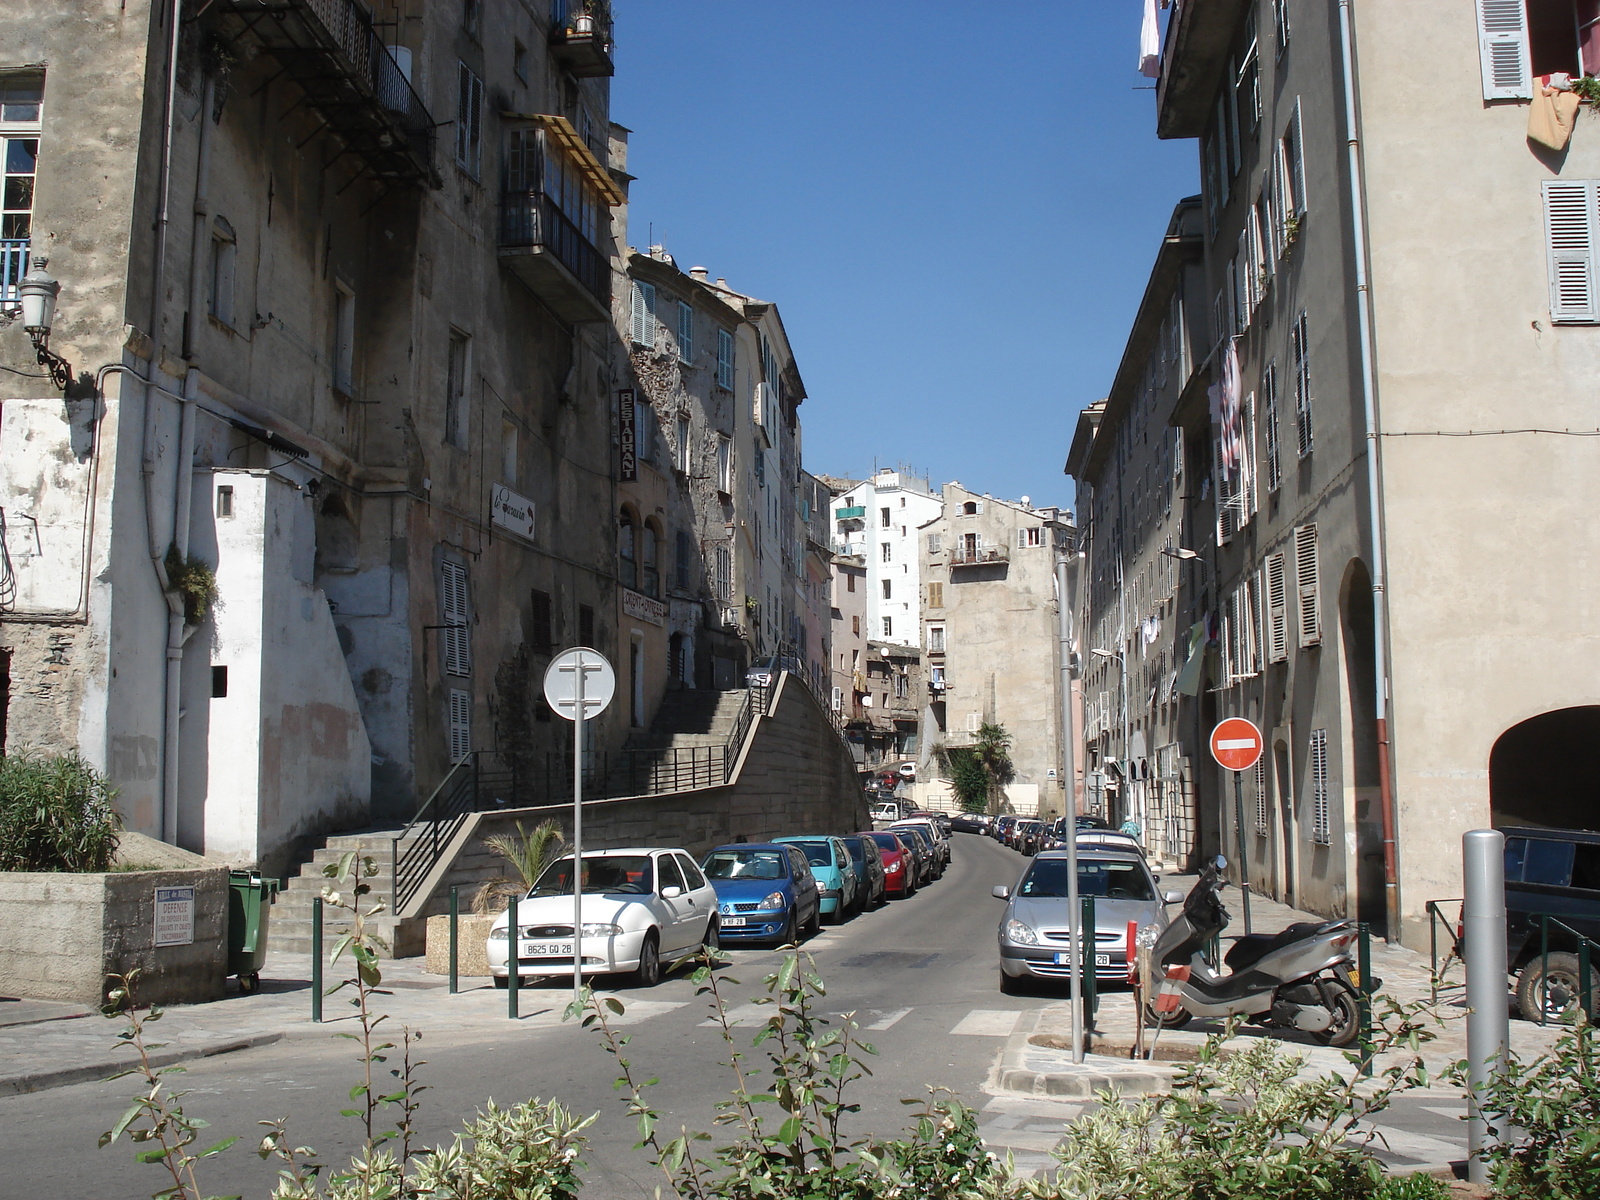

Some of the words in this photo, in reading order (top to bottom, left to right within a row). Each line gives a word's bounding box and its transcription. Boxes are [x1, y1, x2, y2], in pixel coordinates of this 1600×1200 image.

[621, 393, 634, 478] RESTAURANT
[163, 902, 187, 914] DEFENSE
[528, 945, 546, 954] 8625
